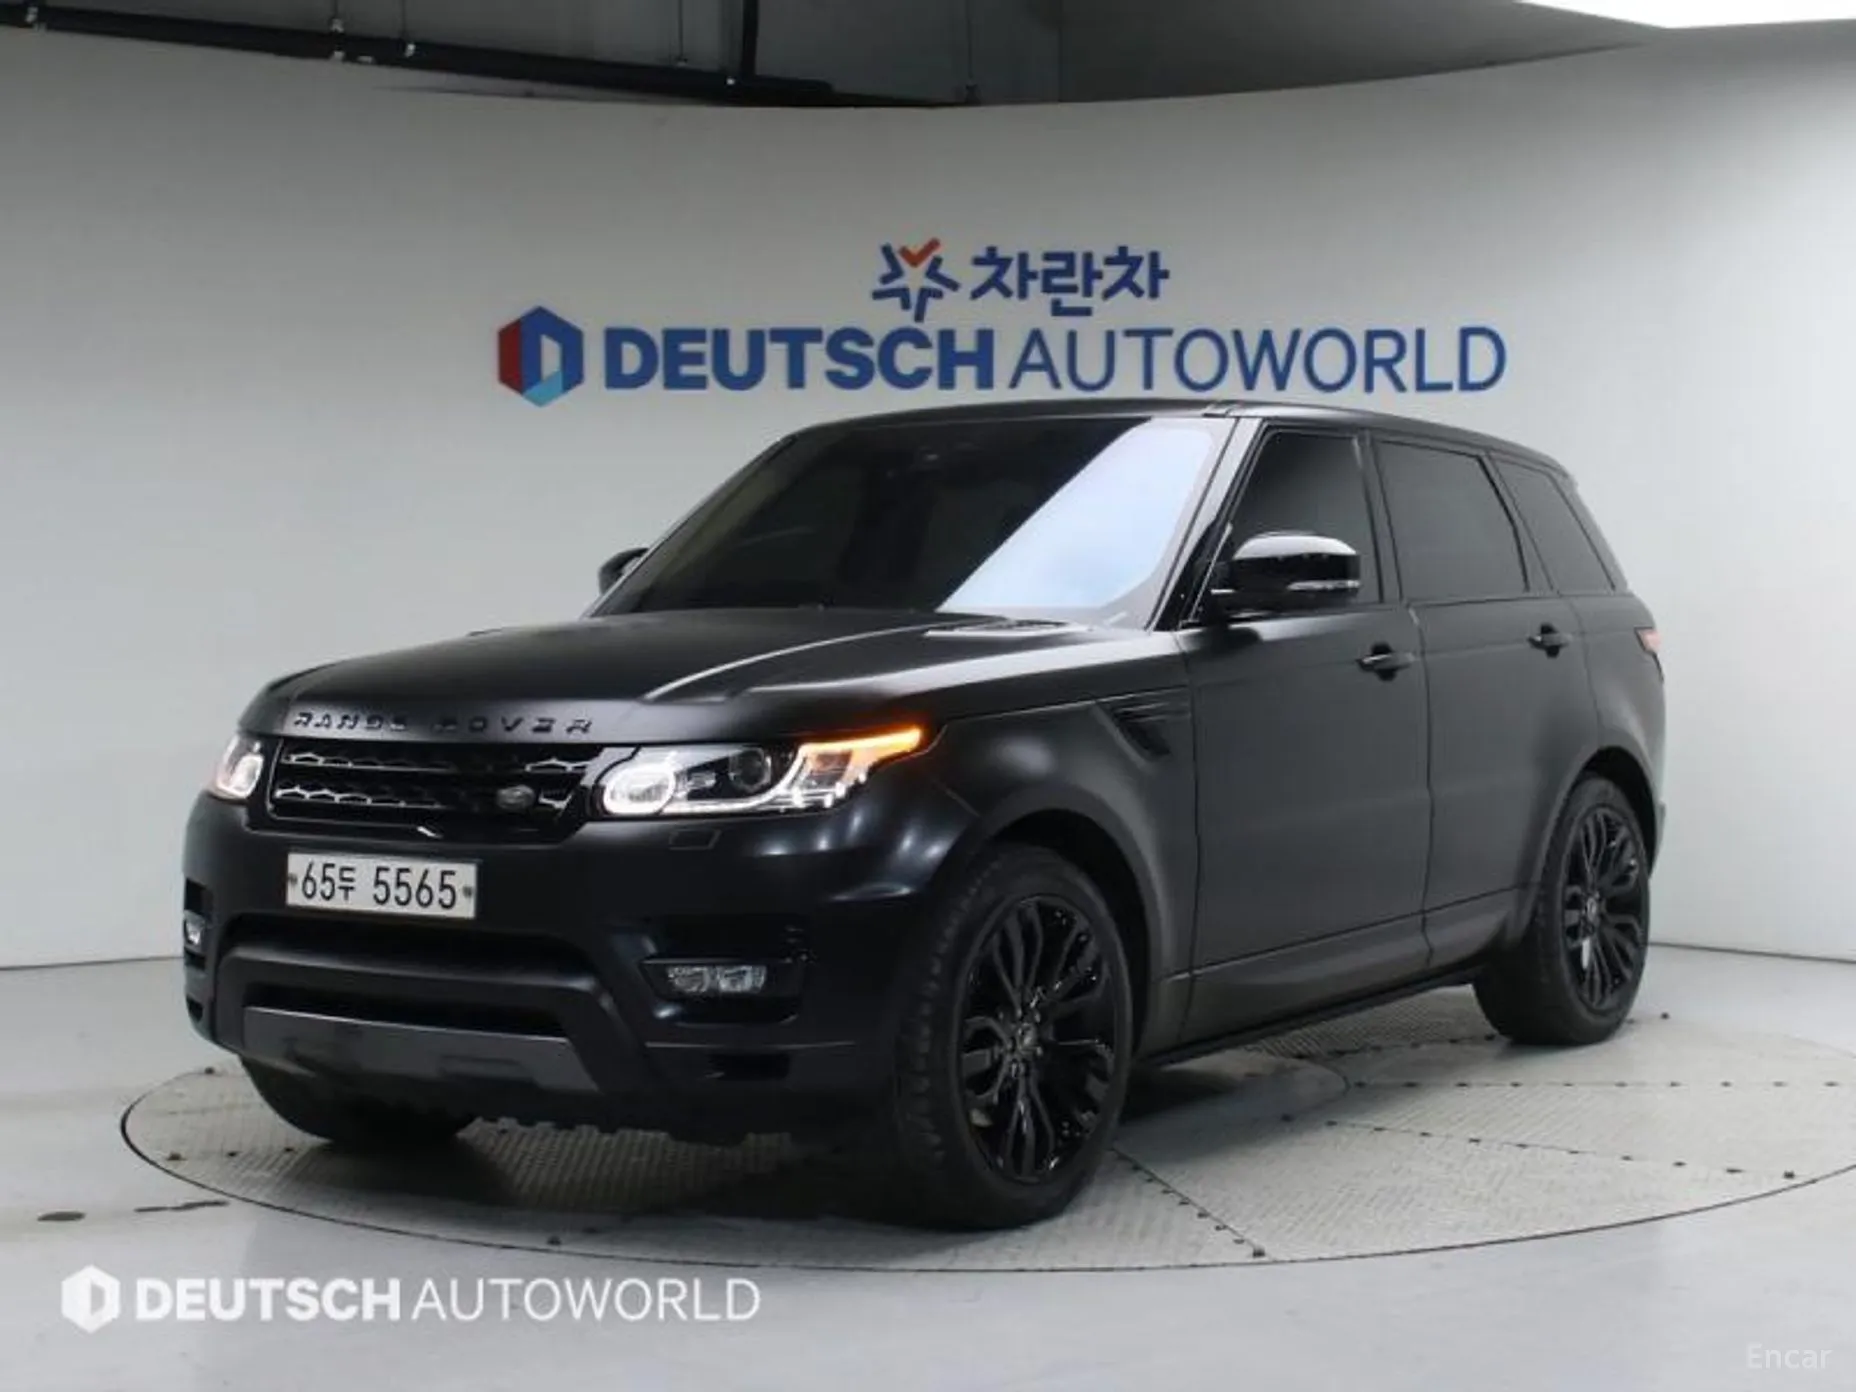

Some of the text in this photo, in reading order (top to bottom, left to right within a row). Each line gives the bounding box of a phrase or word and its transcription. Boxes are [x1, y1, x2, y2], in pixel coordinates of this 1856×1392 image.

[970, 246, 1170, 318] 차란차
[604, 327, 1507, 392] DEUTSCH AUTOWORLD
[300, 862, 458, 910] 65두 5565
